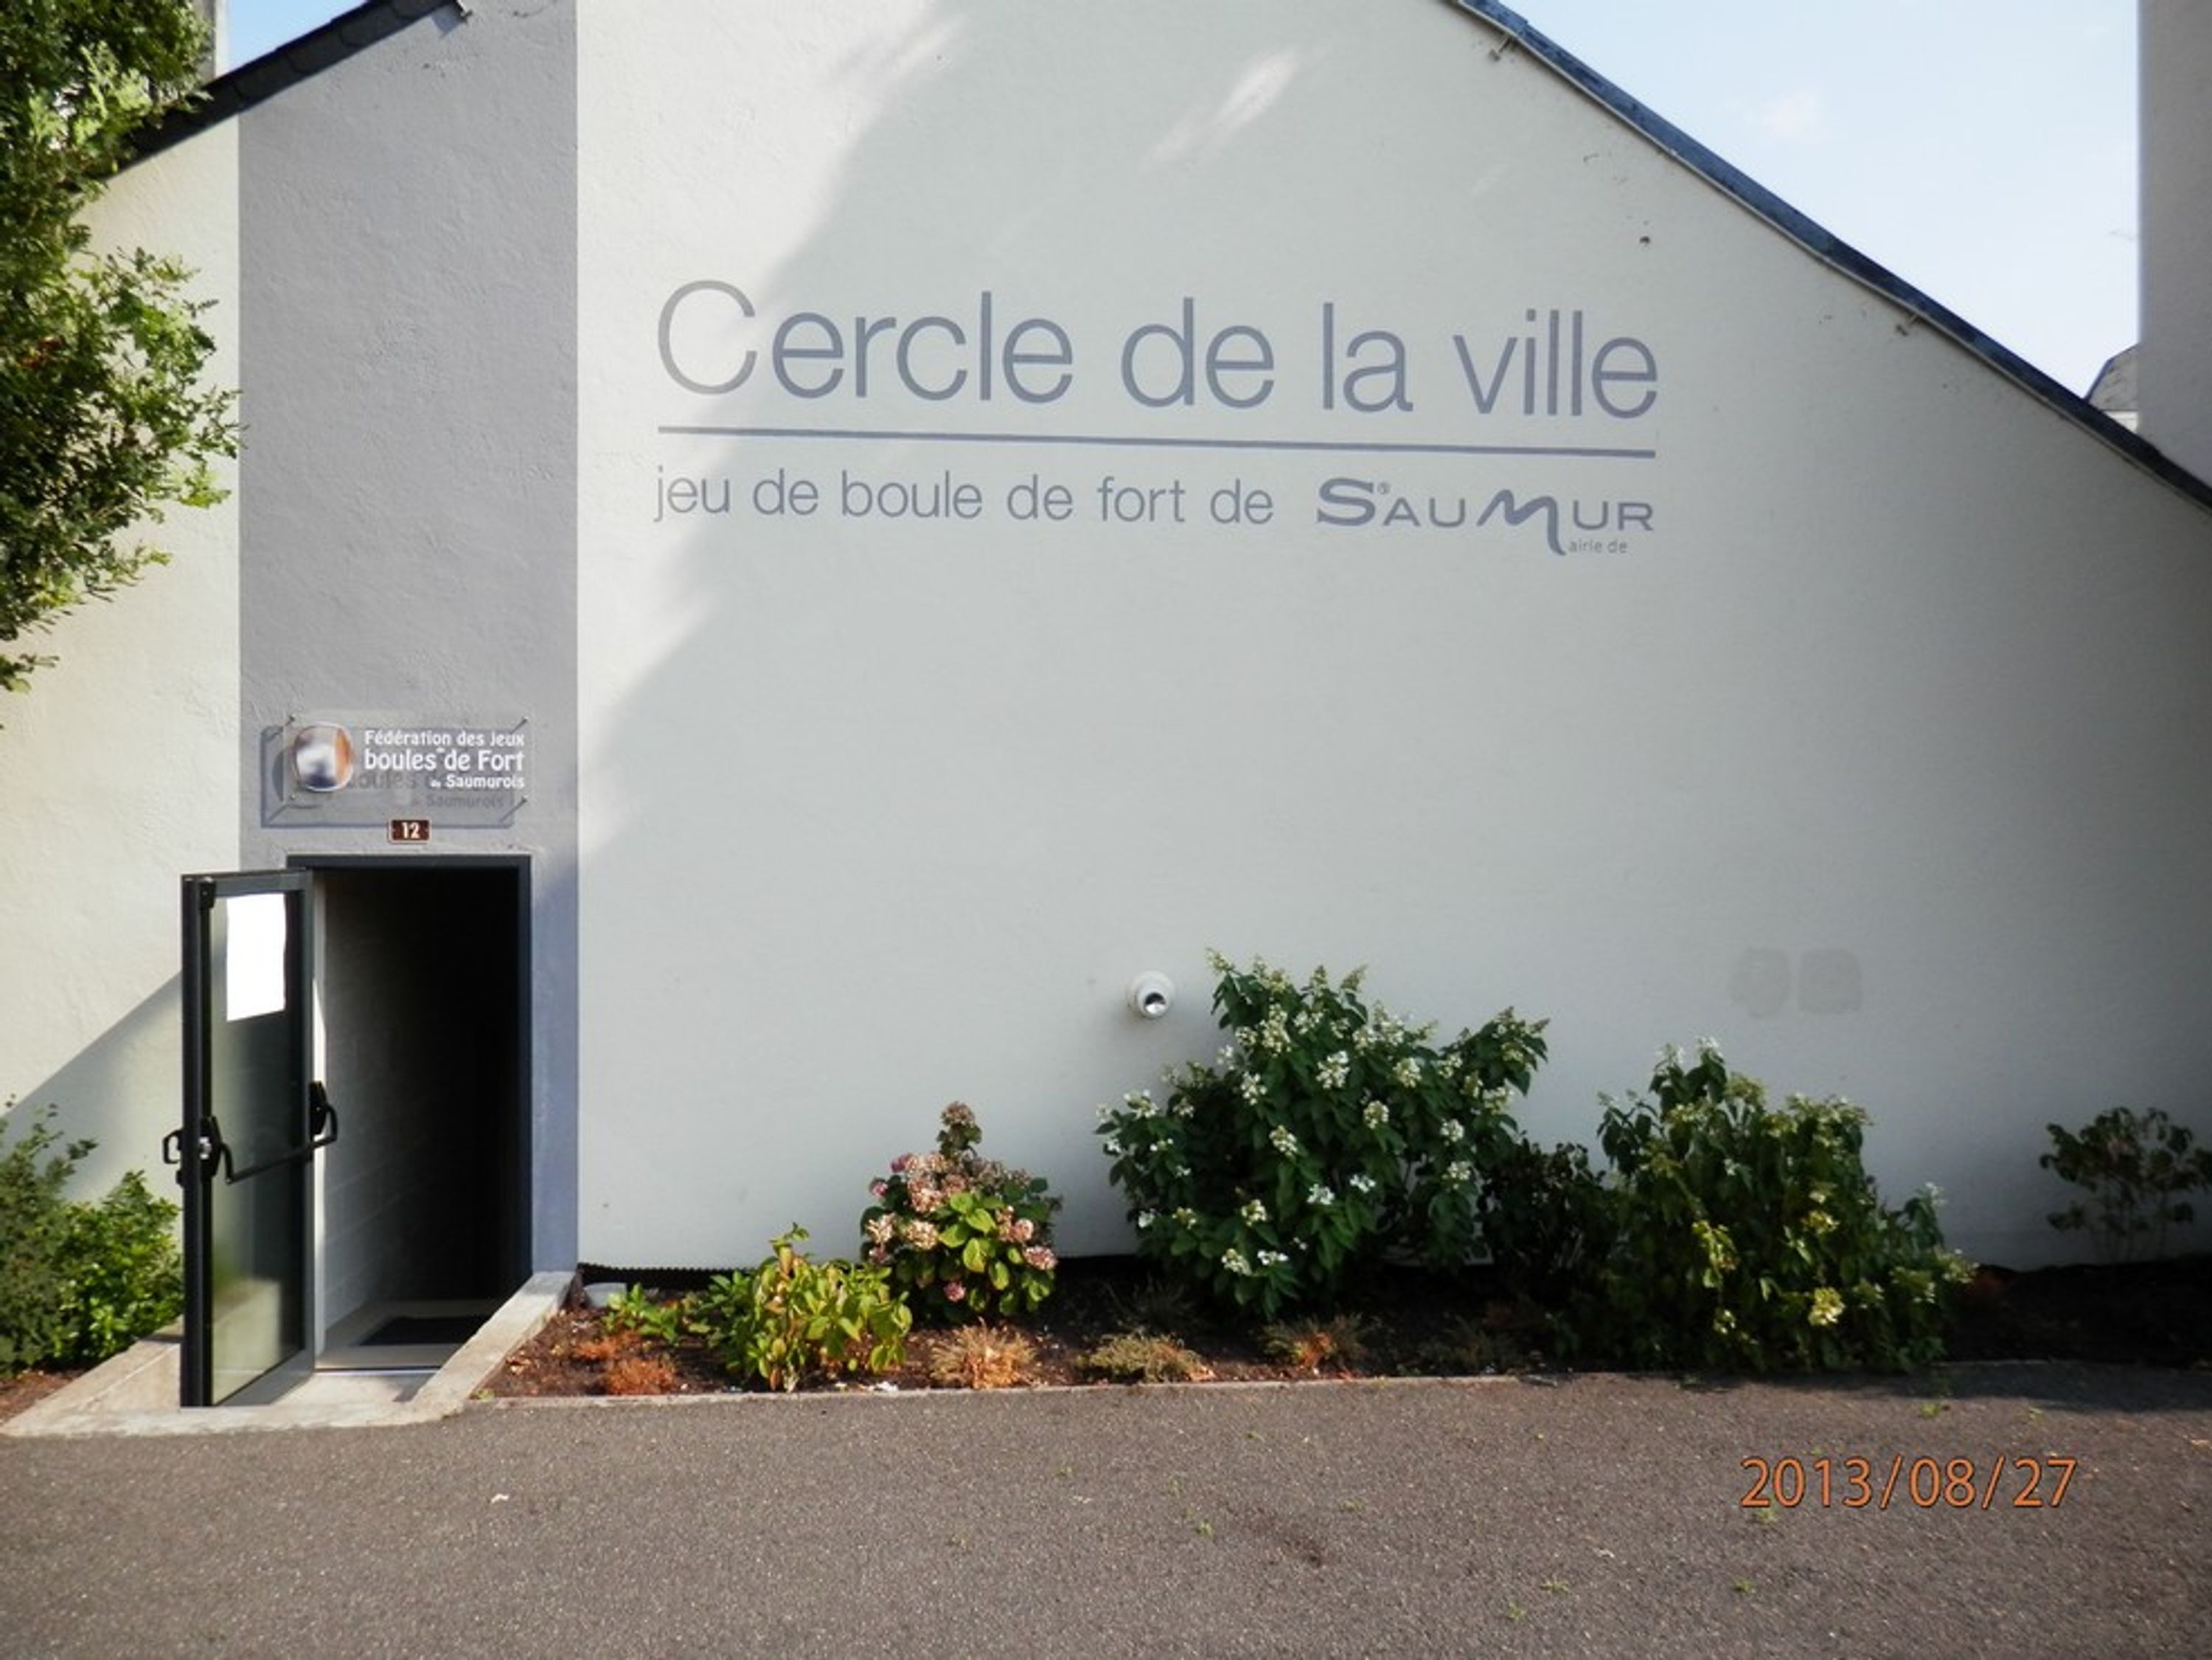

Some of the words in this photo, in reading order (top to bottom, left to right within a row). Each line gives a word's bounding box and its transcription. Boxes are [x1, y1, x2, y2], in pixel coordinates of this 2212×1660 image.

[658, 279, 1073, 403] Cercle
[1121, 296, 1275, 409] de
[1323, 302, 1413, 412] la
[1453, 309, 1658, 419] ville
[654, 465, 730, 522] jeu
[752, 468, 818, 515] de
[841, 470, 983, 518] boule
[1007, 474, 1072, 518] de
[1097, 476, 1186, 522] fort
[1209, 479, 1273, 524] de
[364, 729, 452, 746] Fédération
[456, 730, 484, 746] des
[364, 749, 437, 771] boules
[444, 748, 470, 771] de
[479, 750, 525, 771] Fort
[445, 775, 525, 789] Saumurois
[401, 822, 421, 839] 12
